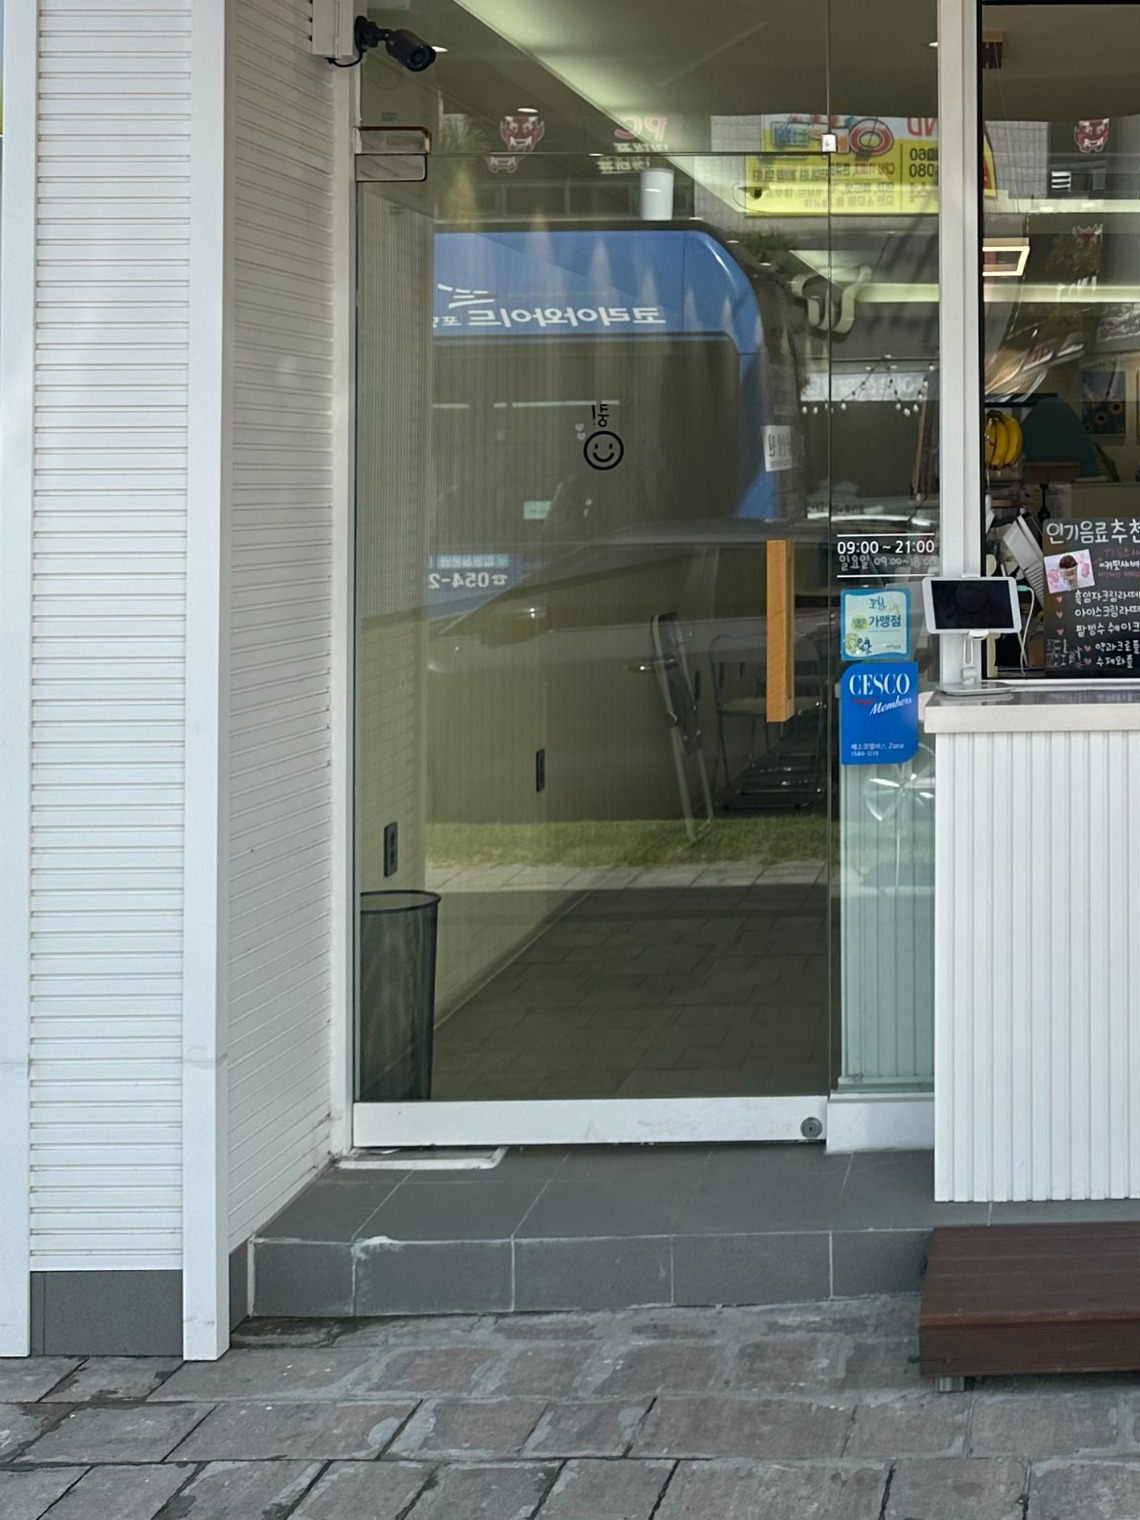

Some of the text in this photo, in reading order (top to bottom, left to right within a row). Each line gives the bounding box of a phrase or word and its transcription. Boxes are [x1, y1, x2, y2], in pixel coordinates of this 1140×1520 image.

[837, 540, 879, 555] 09:00
[895, 540, 935, 554] 21:00
[839, 555, 870, 571] 일요일
[868, 614, 901, 628] 가맹점
[849, 673, 910, 695] CESCO
[869, 695, 913, 716] Members
[888, 742, 905, 750] Zone
